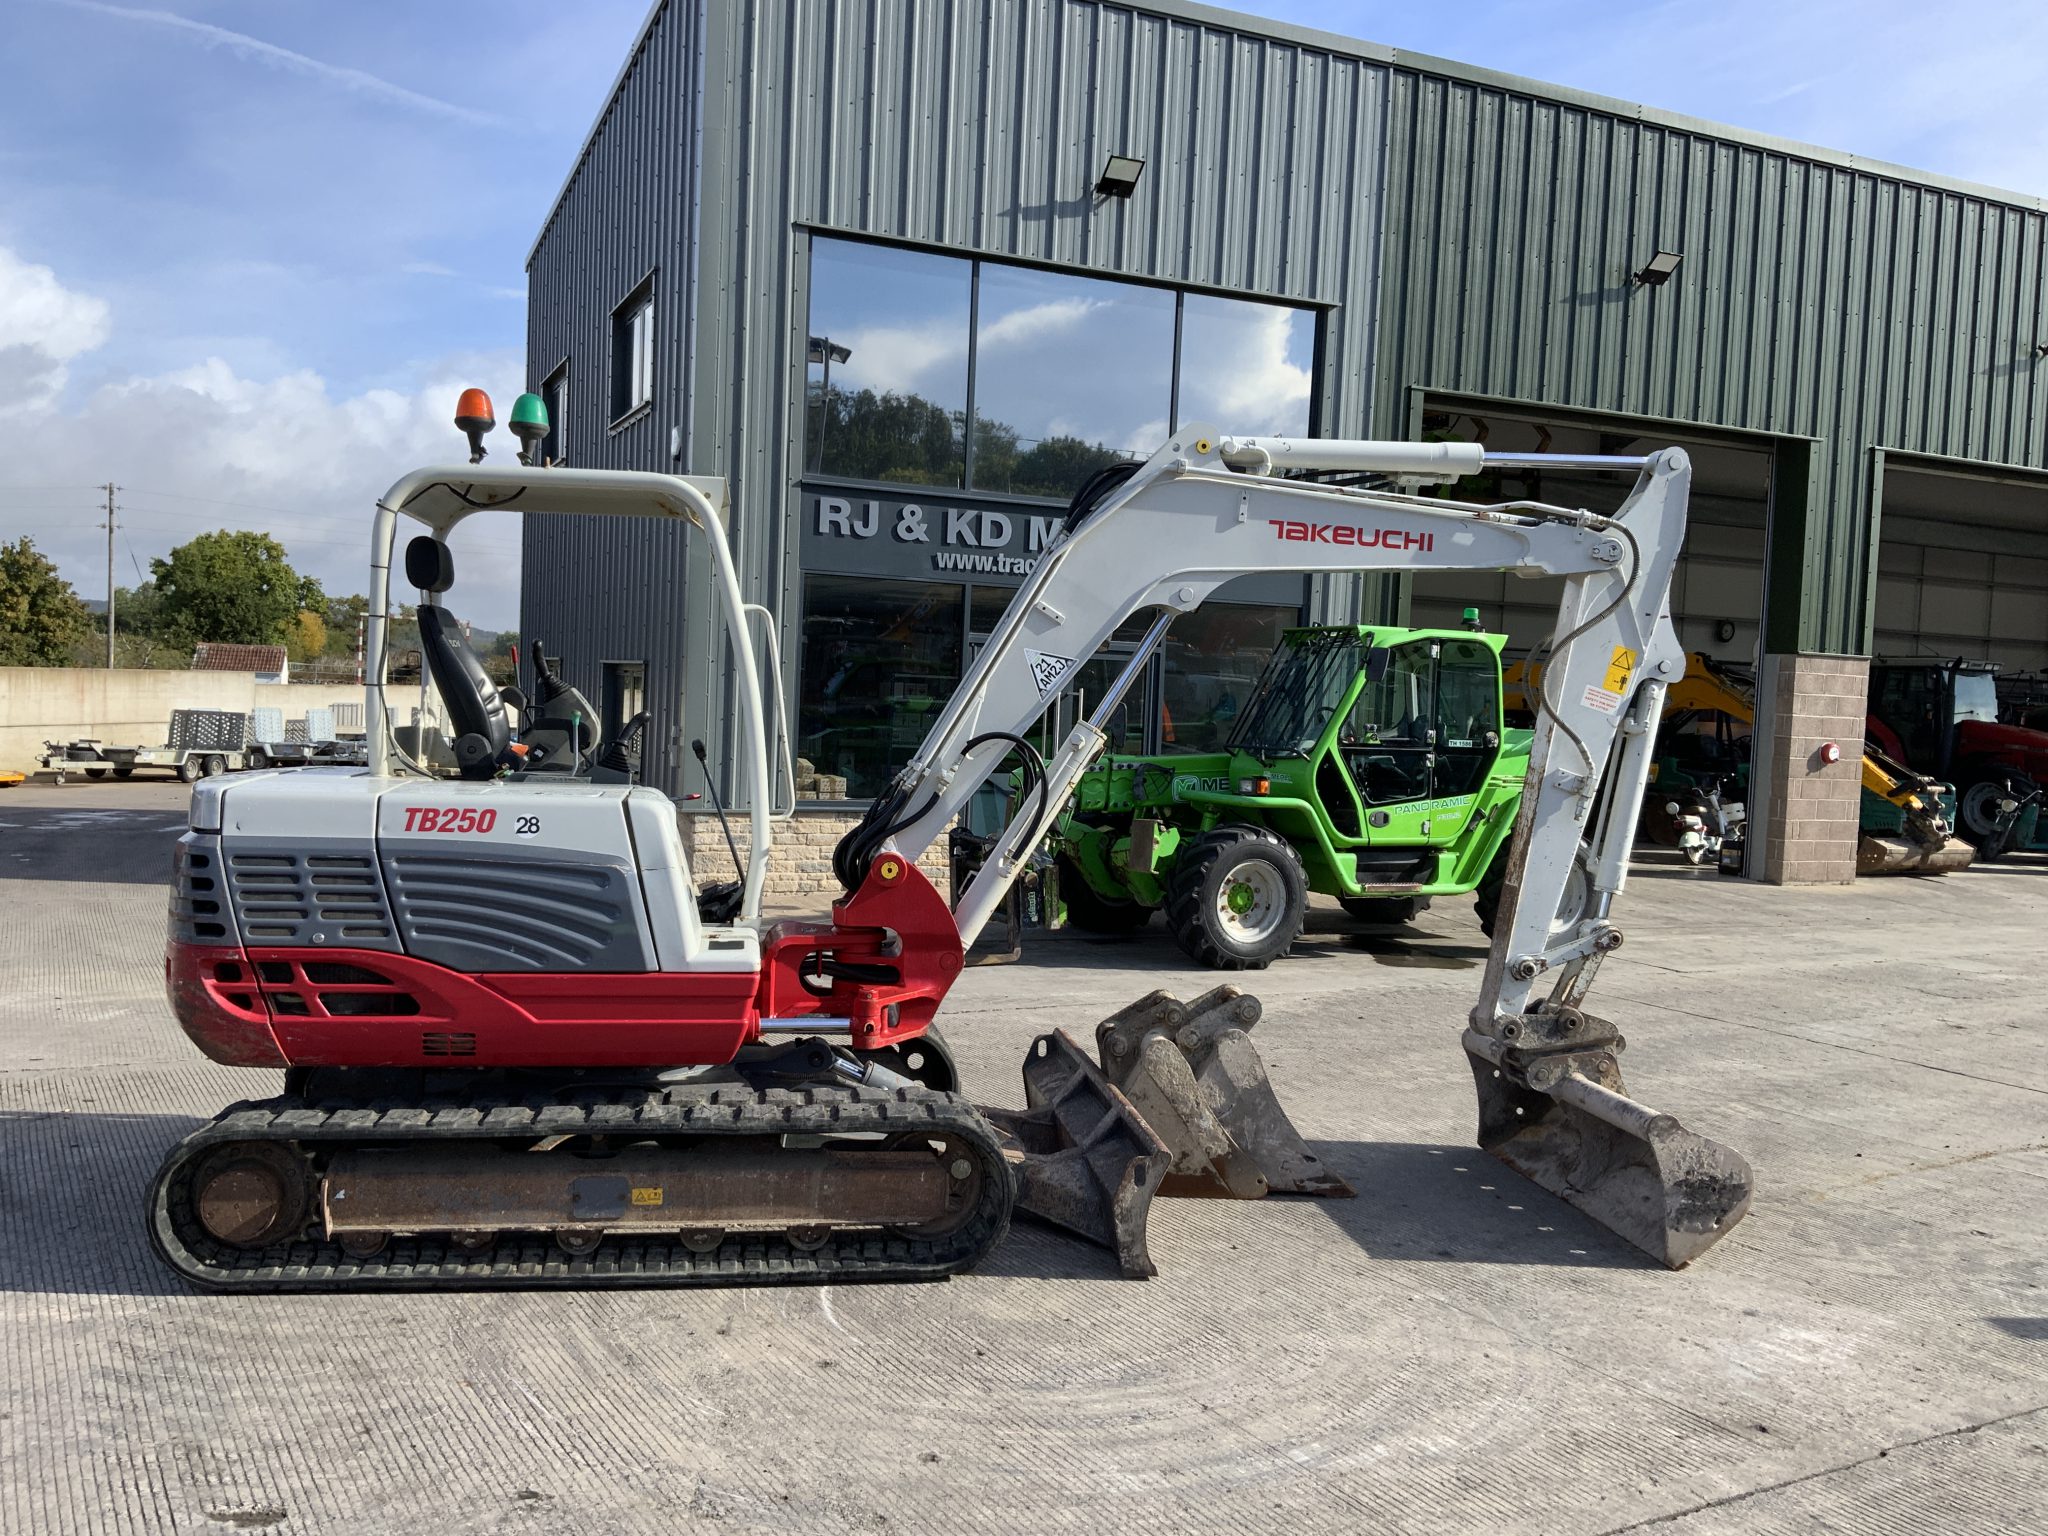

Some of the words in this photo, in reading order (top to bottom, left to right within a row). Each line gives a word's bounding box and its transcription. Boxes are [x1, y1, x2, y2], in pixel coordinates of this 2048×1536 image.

[819, 497, 880, 537] RJ
[896, 503, 930, 542] &
[946, 508, 1013, 548] KD
[1268, 519, 1434, 552] TAKEUCHI
[936, 551, 1041, 575] www.trac
[1035, 658, 1051, 674] 21
[1040, 659, 1066, 688] AM2J
[1394, 795, 1471, 815] PANORAMIC
[404, 807, 498, 834] TB250
[515, 816, 541, 835] 28
